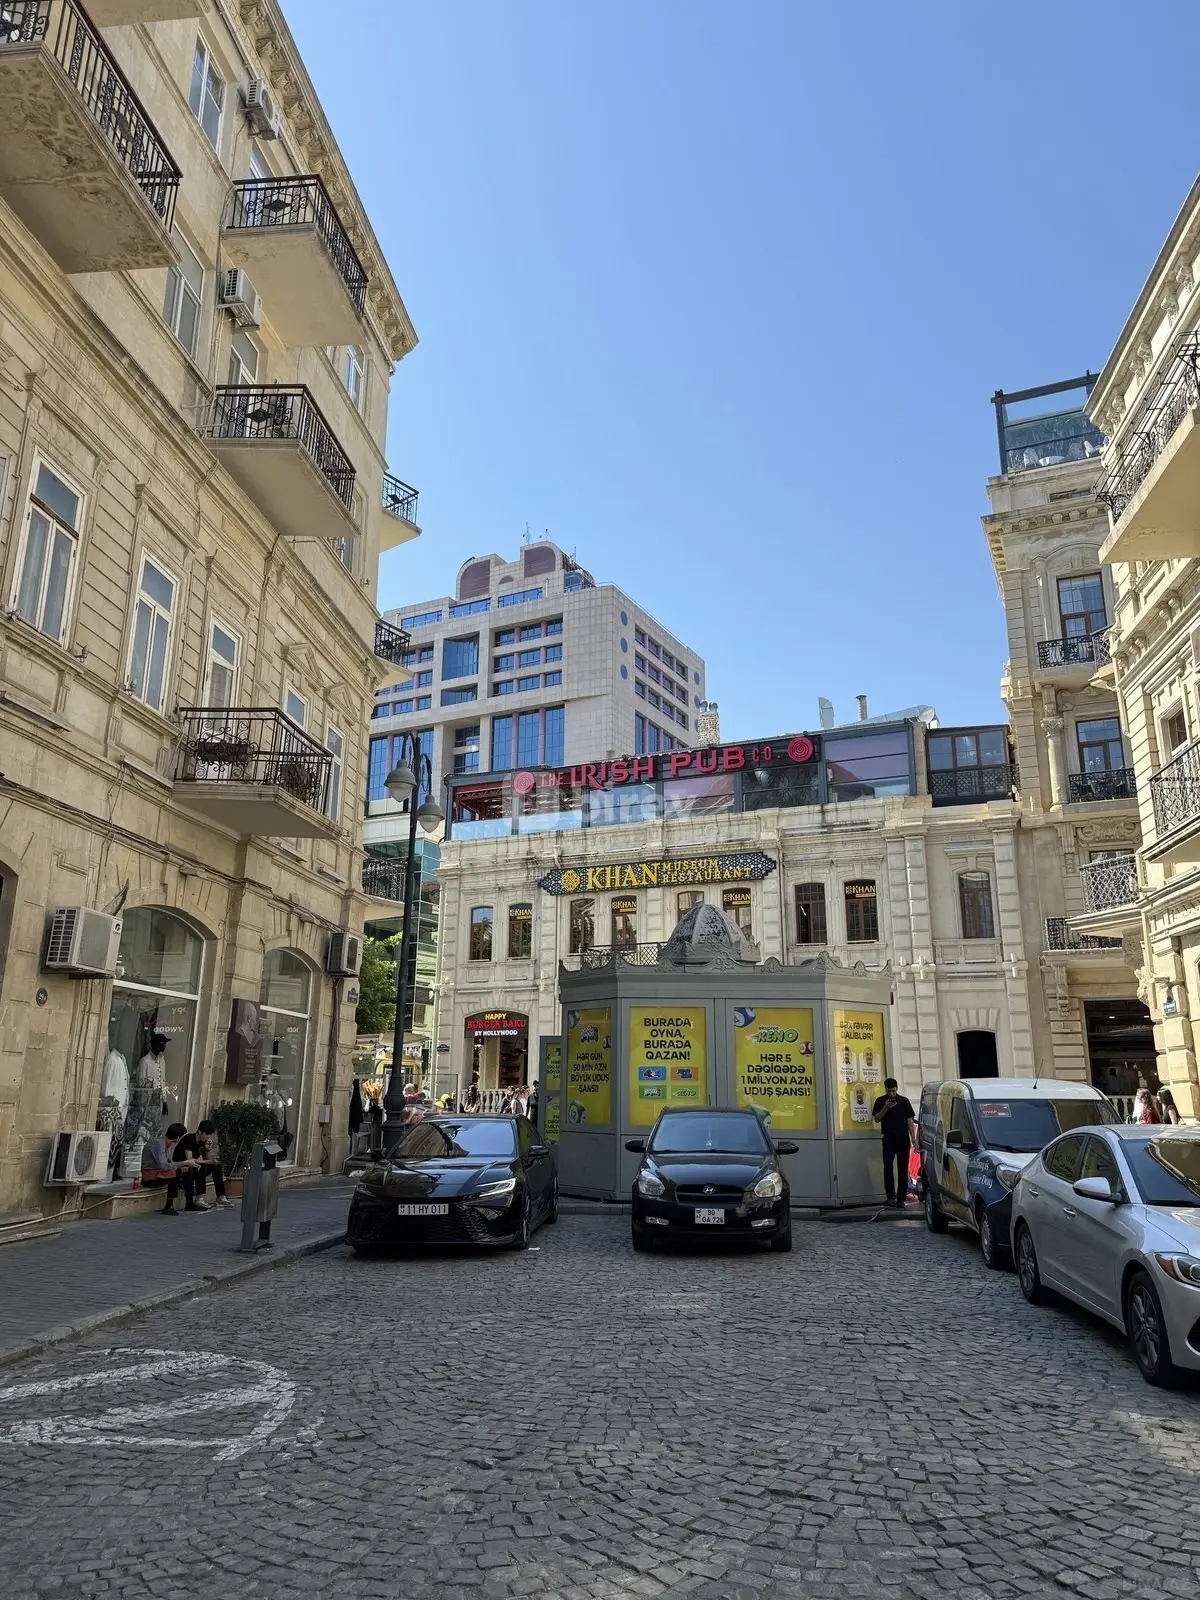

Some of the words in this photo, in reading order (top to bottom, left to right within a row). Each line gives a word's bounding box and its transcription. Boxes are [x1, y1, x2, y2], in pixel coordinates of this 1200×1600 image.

[540, 772, 564, 787] THE
[570, 757, 656, 791] IRISH
[671, 746, 746, 777] PUB
[663, 858, 719, 872] MUSEUM
[586, 862, 660, 890] KHAN
[663, 867, 752, 883] RESTAURANT
[852, 885, 876, 894] KHAN
[729, 892, 751, 901] KHAN
[617, 900, 637, 909] KHAN
[467, 1020, 500, 1029] BURGER
[503, 1019, 527, 1028] BAKU
[643, 1018, 692, 1027] BURADA
[650, 1028, 685, 1039] OYNA,
[757, 1028, 799, 1043] KENO
[643, 1040, 692, 1049] BURADA
[645, 1051, 690, 1061] QAZAN!
[760, 1054, 783, 1062] HƏR
[785, 1054, 792, 1063] 5
[595, 1063, 607, 1071] AZN
[747, 1063, 806, 1074] DƏQİQƏDƏ
[741, 1075, 746, 1084] 1
[747, 1074, 787, 1085] MİLYON
[789, 1076, 812, 1085] AZN
[744, 1087, 774, 1098] UDUŞ
[408, 1205, 416, 1214] 11
[418, 1205, 429, 1214] HY
[431, 1204, 446, 1214] 011
